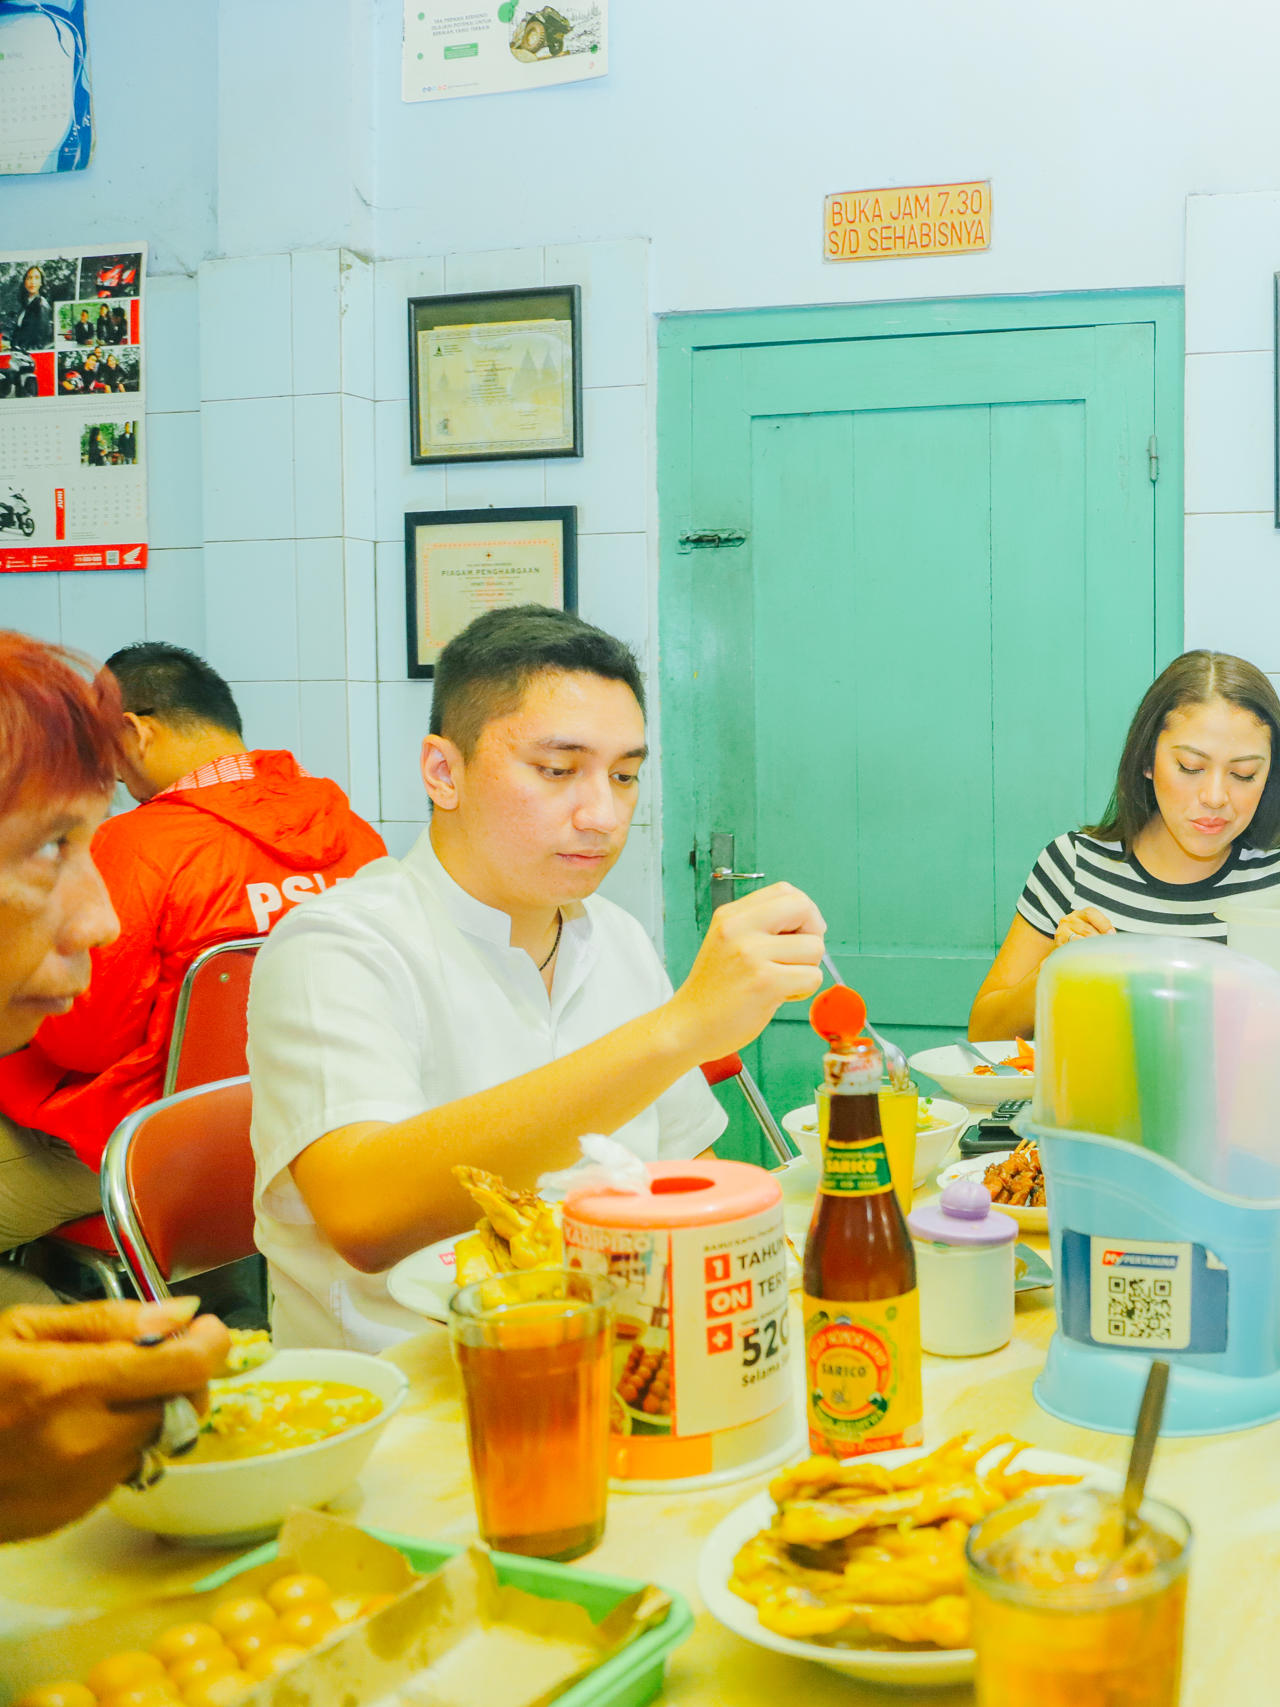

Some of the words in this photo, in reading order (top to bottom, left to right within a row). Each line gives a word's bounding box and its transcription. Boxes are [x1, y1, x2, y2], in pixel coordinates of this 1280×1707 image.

[832, 198, 882, 226] BUKA
[890, 194, 930, 220] JAM
[938, 189, 982, 216] 7.30
[828, 229, 859, 255] S/D
[868, 219, 985, 251] SEHABISNYA
[476, 567, 540, 575] PENGHARGAAN
[825, 1159, 877, 1173] SARICO
[712, 1260, 724, 1278] 1
[711, 1286, 747, 1313] ON
[821, 1363, 867, 1377] SARICO
